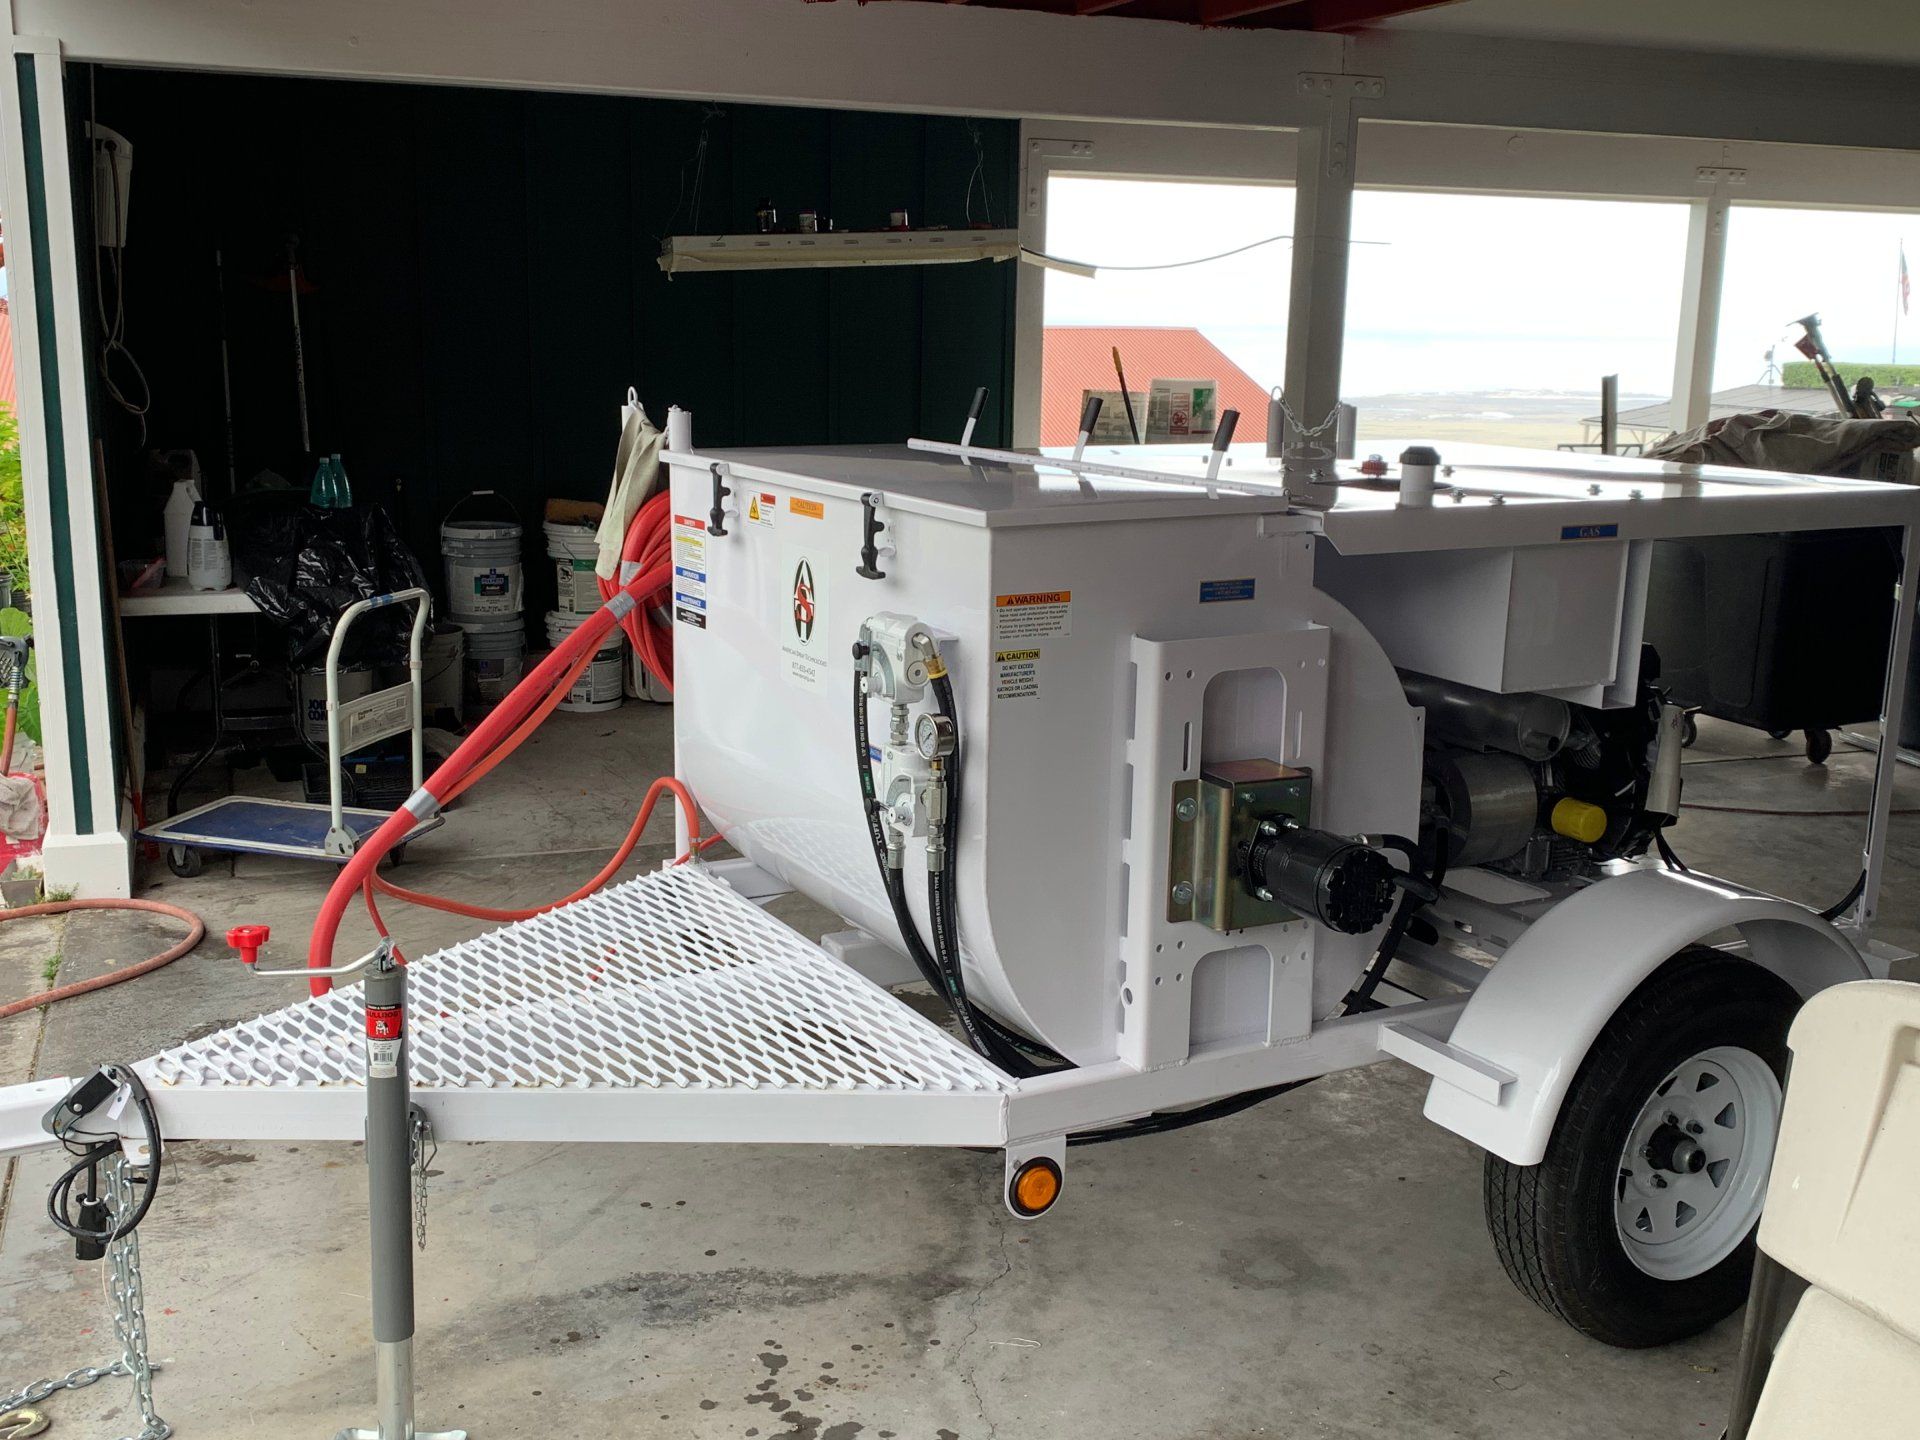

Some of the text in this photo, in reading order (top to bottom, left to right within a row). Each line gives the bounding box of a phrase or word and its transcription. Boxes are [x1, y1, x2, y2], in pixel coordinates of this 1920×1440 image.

[1580, 527, 1600, 537] GAS
[1015, 594, 1060, 604] WARNING
[1007, 651, 1039, 660] CAUTION
